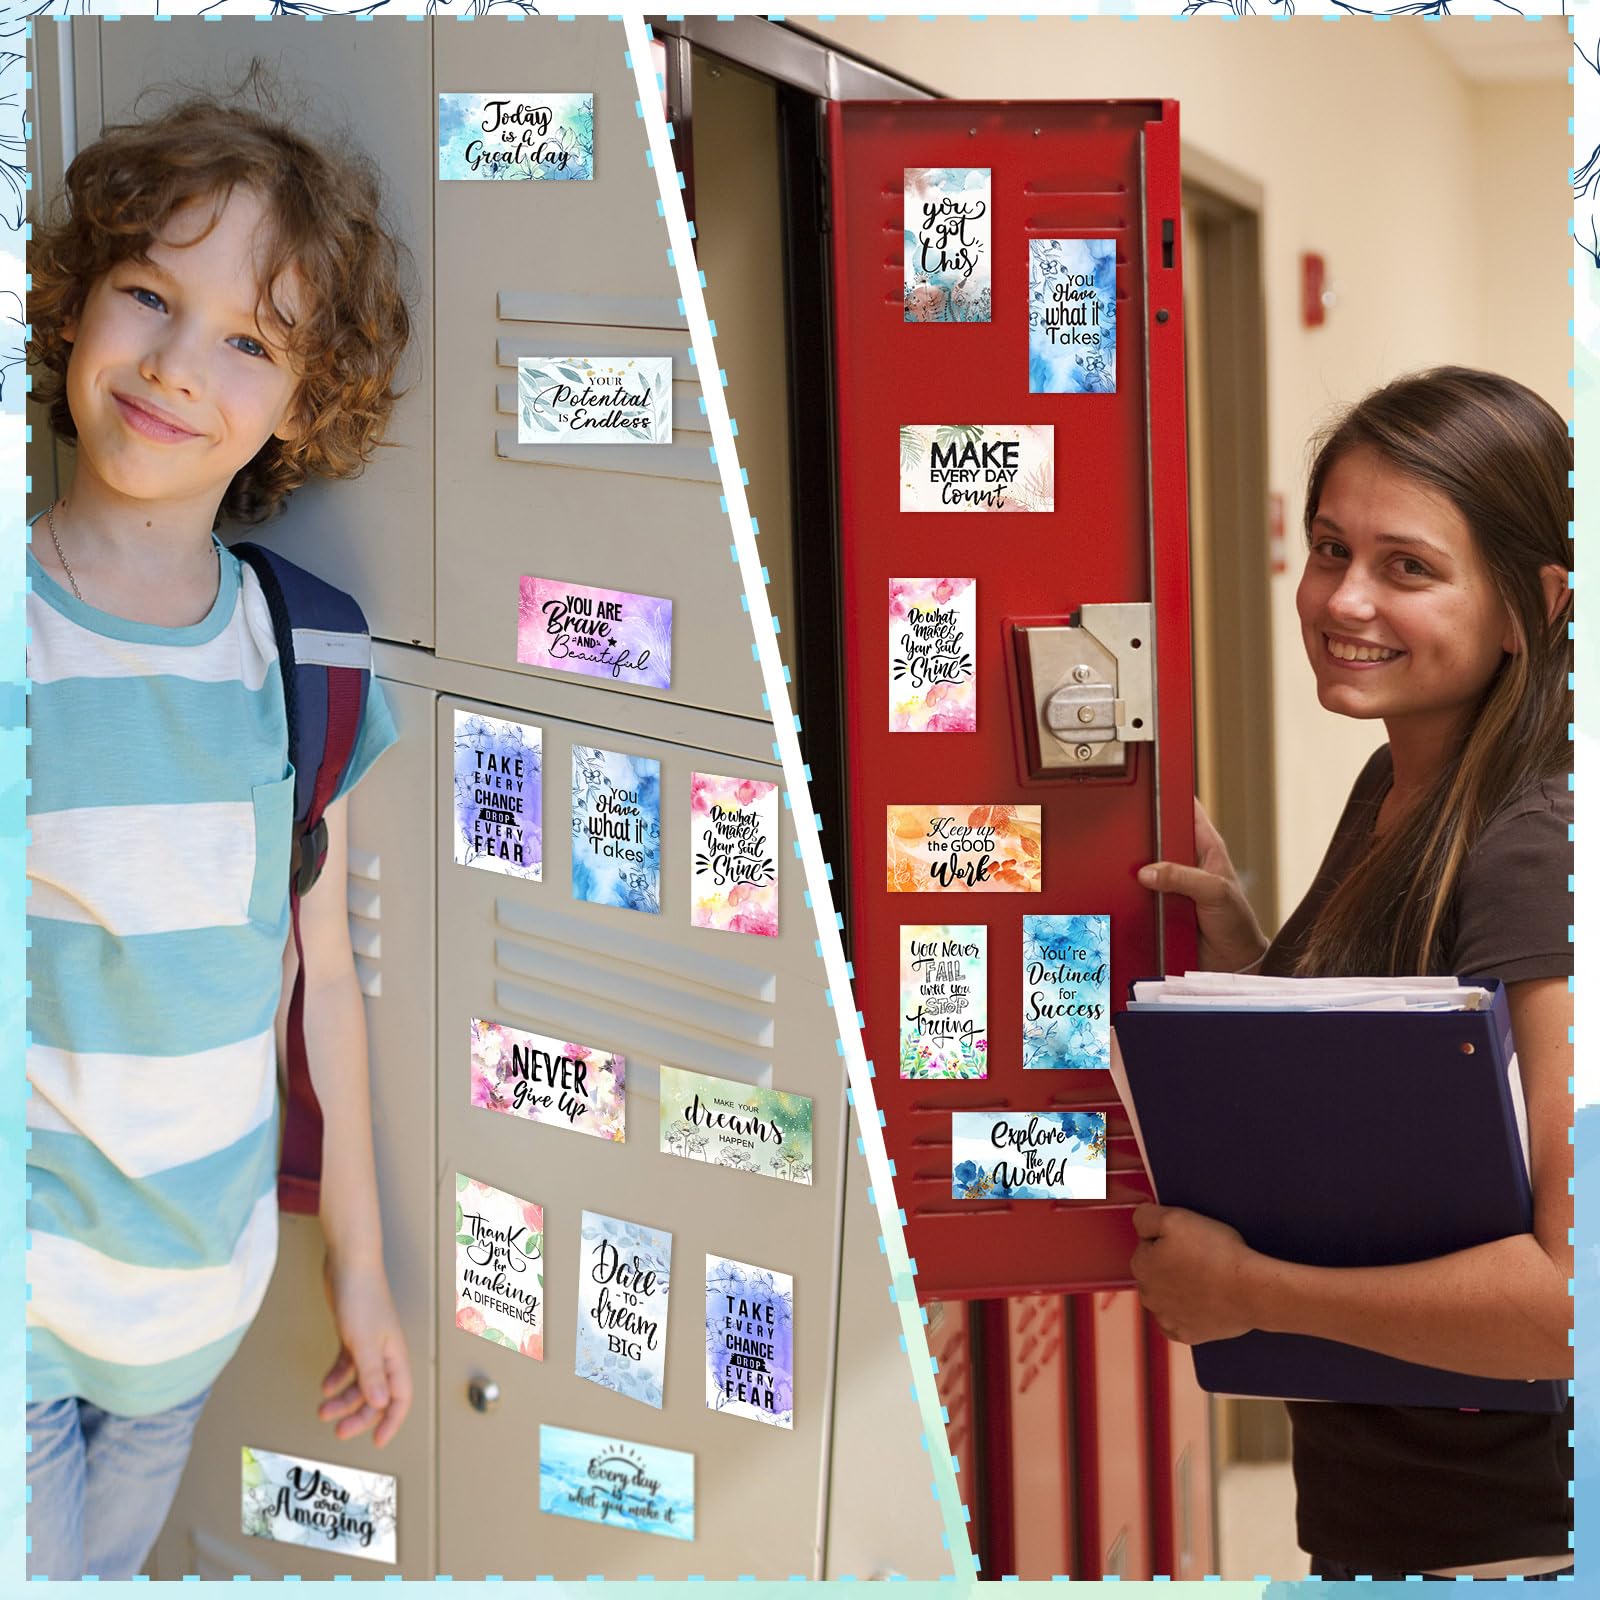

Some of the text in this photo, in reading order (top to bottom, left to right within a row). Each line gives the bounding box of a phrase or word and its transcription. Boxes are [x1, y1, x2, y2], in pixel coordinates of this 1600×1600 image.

[482, 100, 552, 136] Today
[502, 131, 517, 142] is
[465, 140, 570, 171] Great day
[923, 198, 986, 230] you
[936, 214, 975, 249] got
[919, 231, 978, 278] this
[1053, 284, 1096, 302] Have
[1046, 302, 1087, 325] what
[1046, 327, 1100, 344] Takes
[589, 377, 622, 386] YOUR
[534, 384, 651, 413] Potential
[558, 409, 651, 430] IS Endless
[931, 441, 1019, 468] MAKE
[931, 470, 1018, 482] EVERY DAY
[942, 482, 1007, 508] Count
[542, 601, 611, 637] Brave
[566, 596, 622, 622] YOU ARE
[908, 608, 960, 625] Do what
[548, 634, 650, 677] Beautiful
[901, 632, 964, 660] Your Soul
[911, 656, 960, 688] Shine
[475, 751, 523, 778] TAKE
[475, 772, 523, 792] EVERY
[475, 789, 523, 813] CHANCE
[596, 795, 640, 816] Have
[485, 811, 510, 822] DROP
[589, 814, 630, 841] what
[710, 805, 764, 827] Do what
[927, 817, 995, 841] Keep up
[475, 821, 523, 841] EVERY
[703, 830, 766, 857] Your Soul
[475, 835, 523, 862] FEAR
[589, 837, 643, 862] Takes
[928, 840, 994, 852] the GOOD
[713, 855, 763, 885] Shine
[930, 853, 991, 887] Work
[942, 941, 980, 959] Never
[926, 960, 965, 983] FAIL
[1026, 962, 1107, 985] Destined
[925, 997, 969, 1015] STOP
[1026, 991, 1104, 1021] Success
[1059, 988, 1077, 1000] for
[906, 1006, 985, 1049] trying
[512, 1044, 588, 1097] NEVER
[513, 1081, 588, 1123] Give Up
[714, 1098, 759, 1113] MAKE YOUR
[685, 1094, 784, 1144] dreams
[719, 1135, 754, 1149] HAPPEN
[991, 1117, 1066, 1152] Explore
[1022, 1149, 1043, 1169] The
[993, 1158, 1067, 1189] World
[493, 1259, 506, 1272] for
[592, 1239, 656, 1296] Dare
[464, 1268, 540, 1313] making
[462, 1288, 536, 1326] A DIFFERENCE
[591, 1287, 657, 1350] dream
[726, 1296, 774, 1325] TAKE
[726, 1317, 774, 1339] EVERY
[608, 1334, 642, 1361] BIG
[726, 1334, 774, 1360] CHANCE
[736, 1356, 761, 1369] DROP
[726, 1366, 774, 1388] EVERY
[726, 1381, 774, 1409] FEAR
[287, 1466, 350, 1503] You
[588, 1458, 661, 1496] Every day
[314, 1500, 342, 1512] are
[568, 1487, 598, 1508] what
[601, 1501, 623, 1520] you
[628, 1500, 659, 1520] make
[612, 1485, 622, 1500] is
[262, 1486, 375, 1547] Amazing
